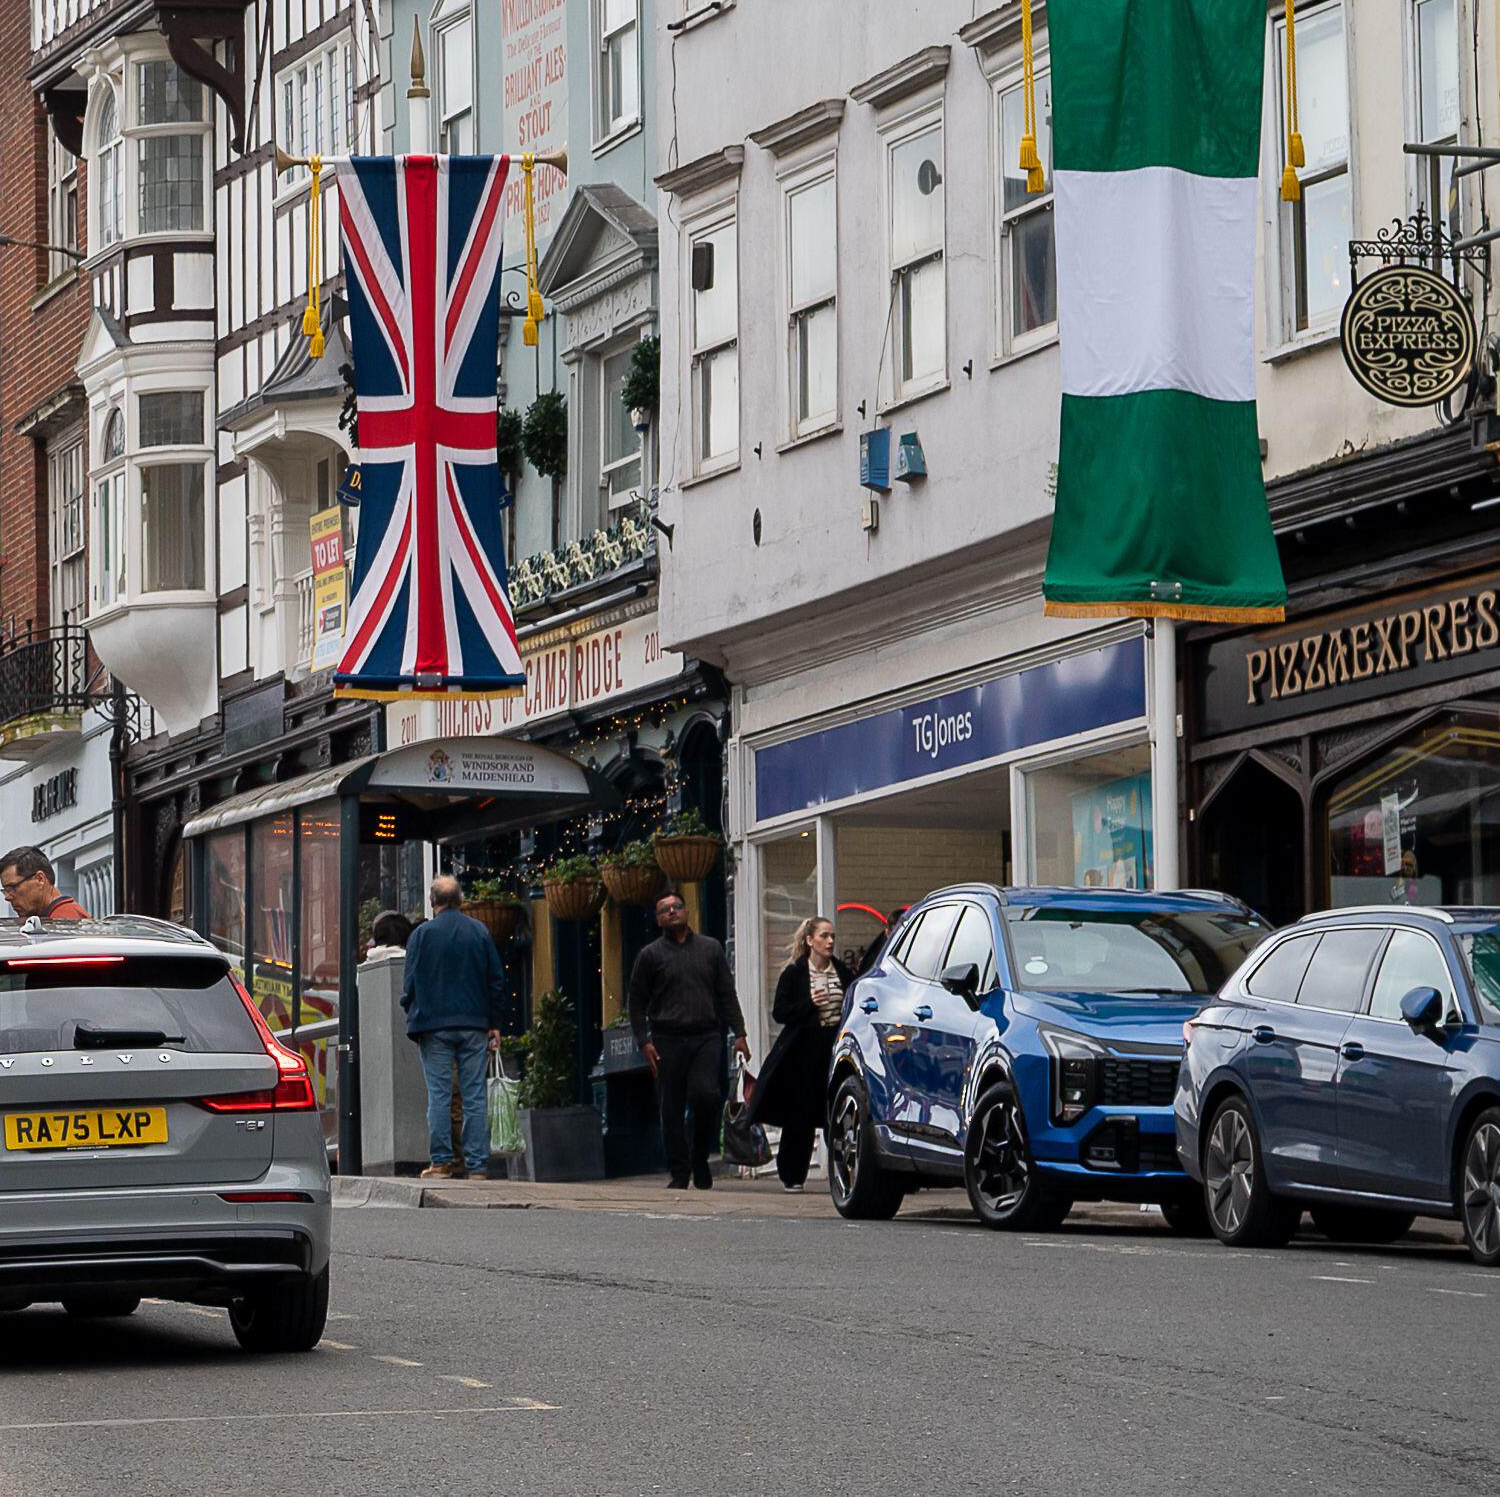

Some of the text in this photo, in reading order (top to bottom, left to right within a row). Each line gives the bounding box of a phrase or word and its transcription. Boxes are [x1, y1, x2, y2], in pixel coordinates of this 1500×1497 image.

[504, 57, 543, 110] BRILLIANT
[518, 100, 552, 147] STOUT
[1376, 316, 1441, 332] PIZZA
[1360, 333, 1460, 349] EXPRESS
[314, 537, 340, 569] TO LET
[524, 630, 623, 717] CAMBRIDGE
[401, 714, 418, 745] 2011
[462, 761, 535, 772] WINDSOR AND
[462, 772, 535, 784] MAIDENHEAD
[610, 1036, 633, 1056] FRESH
[0, 1053, 172, 1069] VOLVO
[16, 1111, 152, 1144] RA75 LXP
